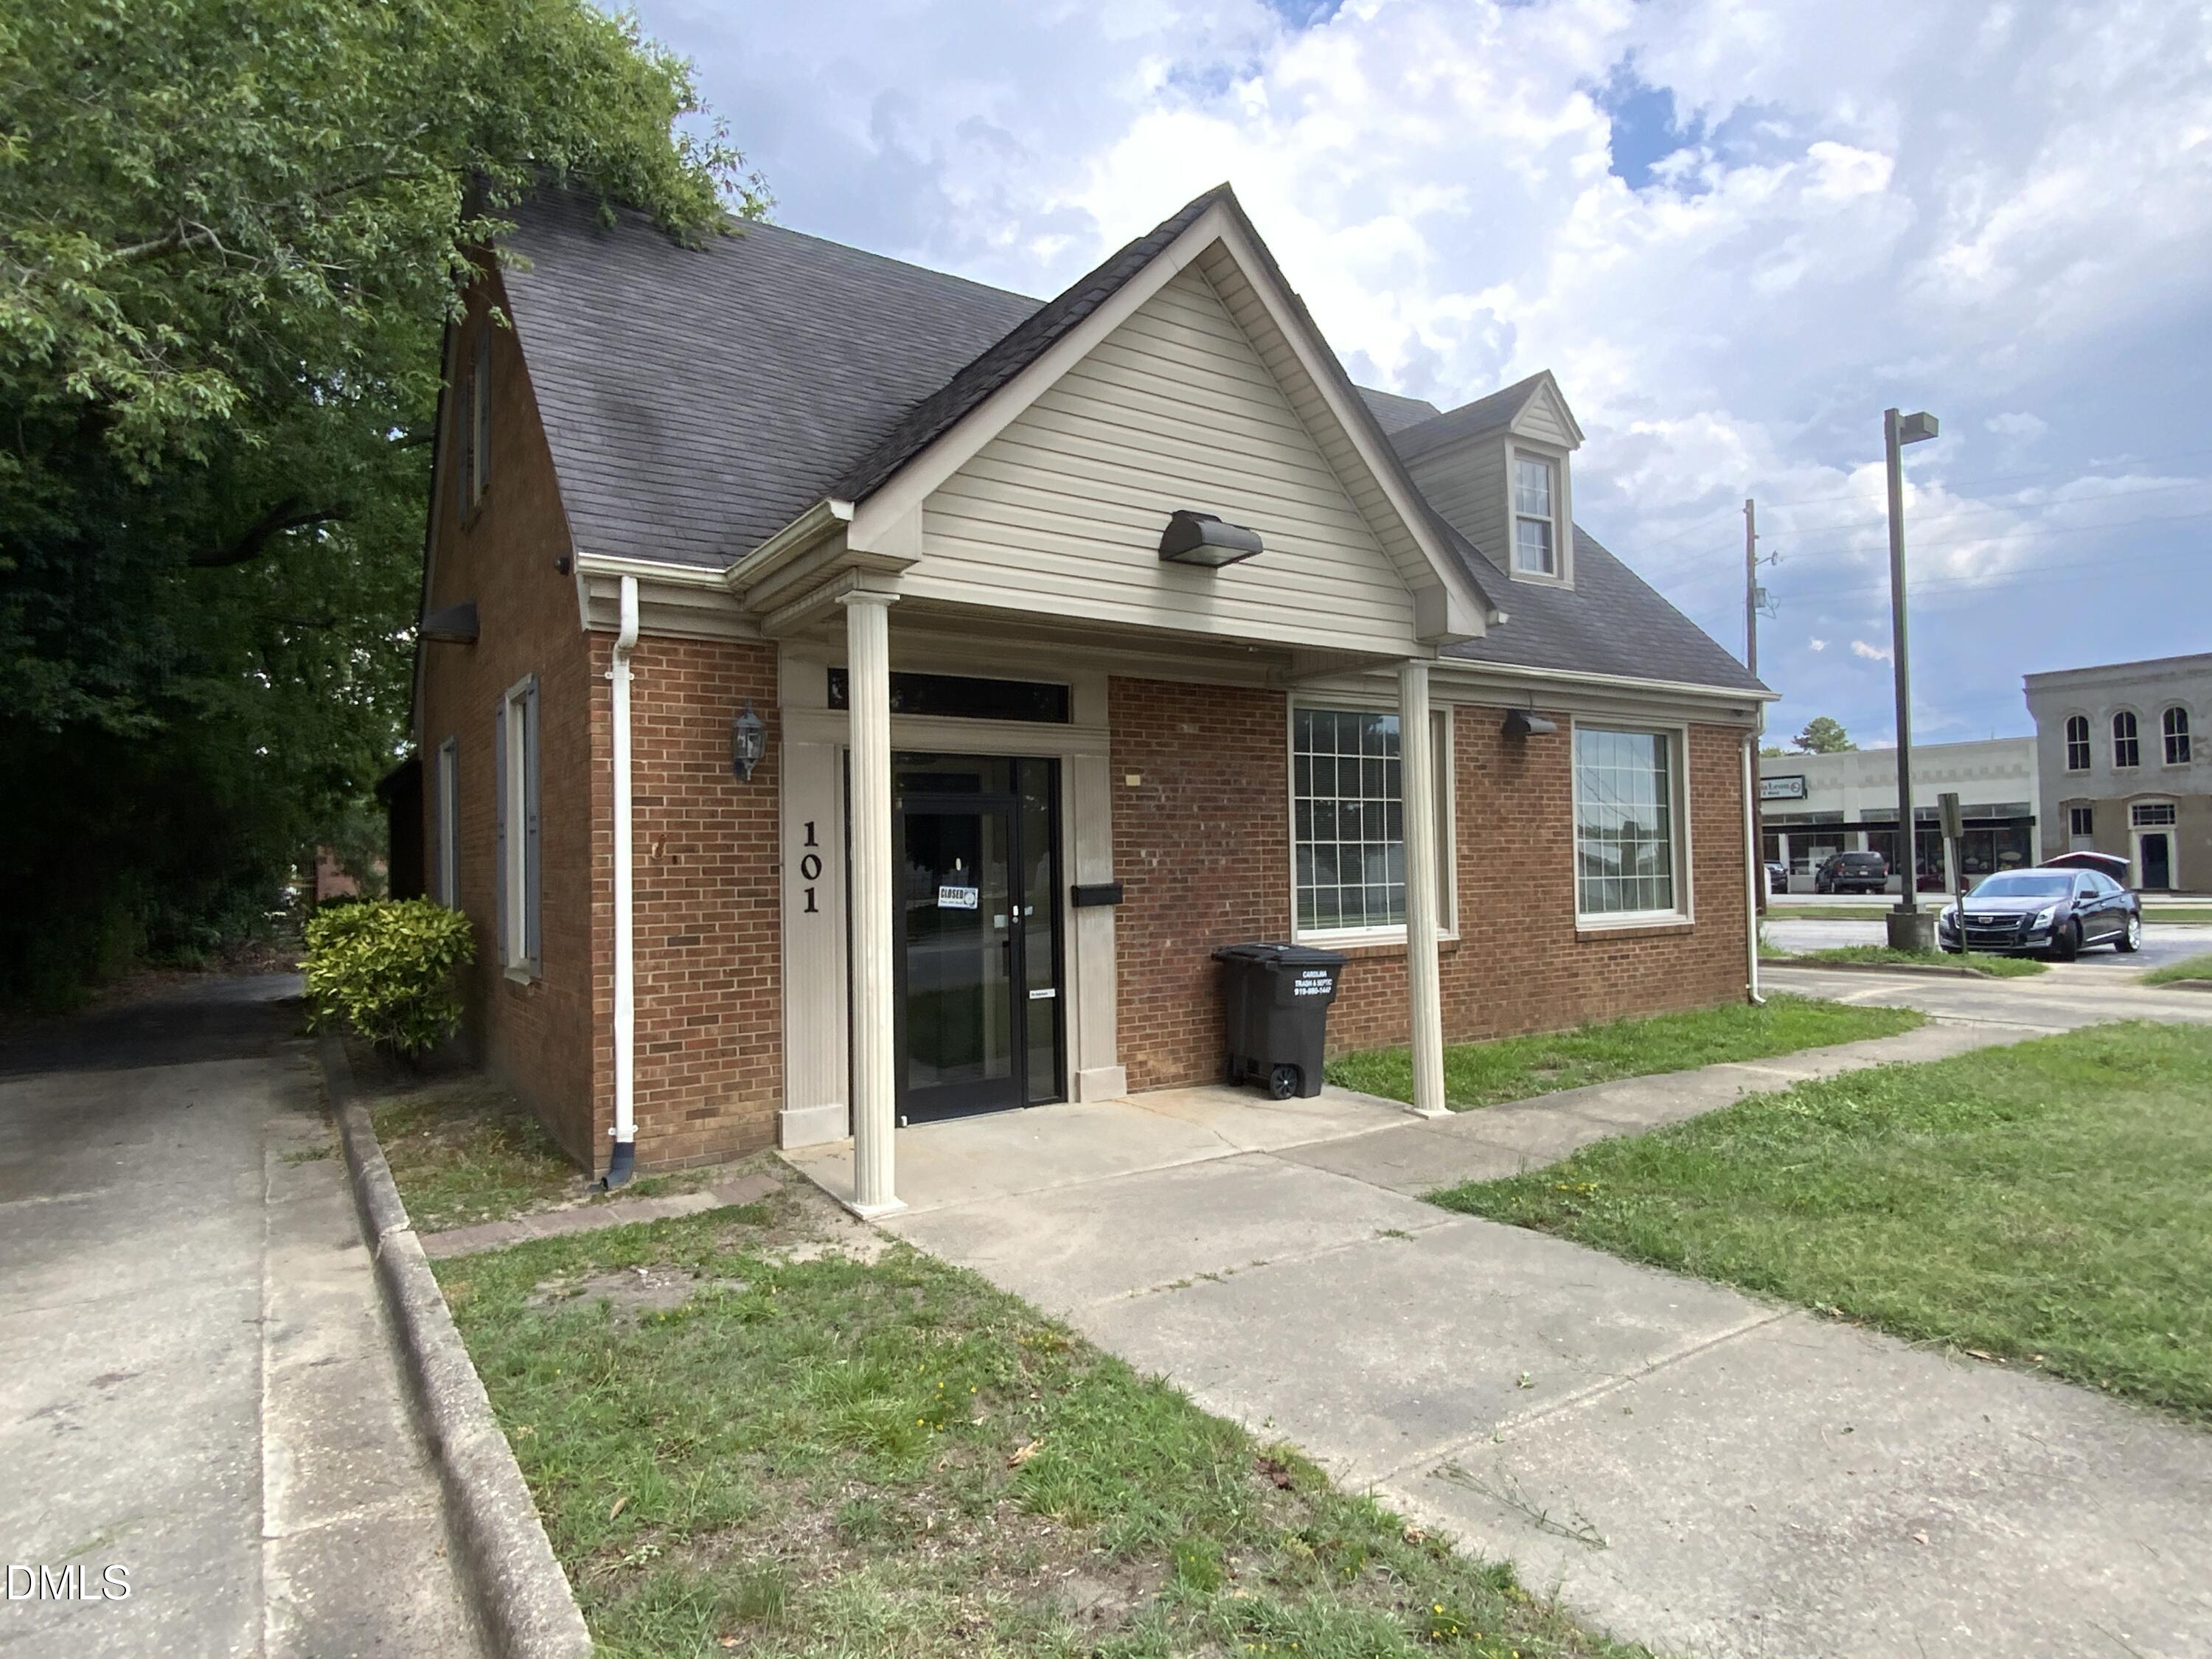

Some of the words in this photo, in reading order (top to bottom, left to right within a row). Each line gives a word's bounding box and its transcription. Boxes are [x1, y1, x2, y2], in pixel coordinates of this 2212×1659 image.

[801, 821, 822, 913] 101
[941, 888, 964, 899] CLOSED
[1302, 970, 1327, 978] CAROLINA
